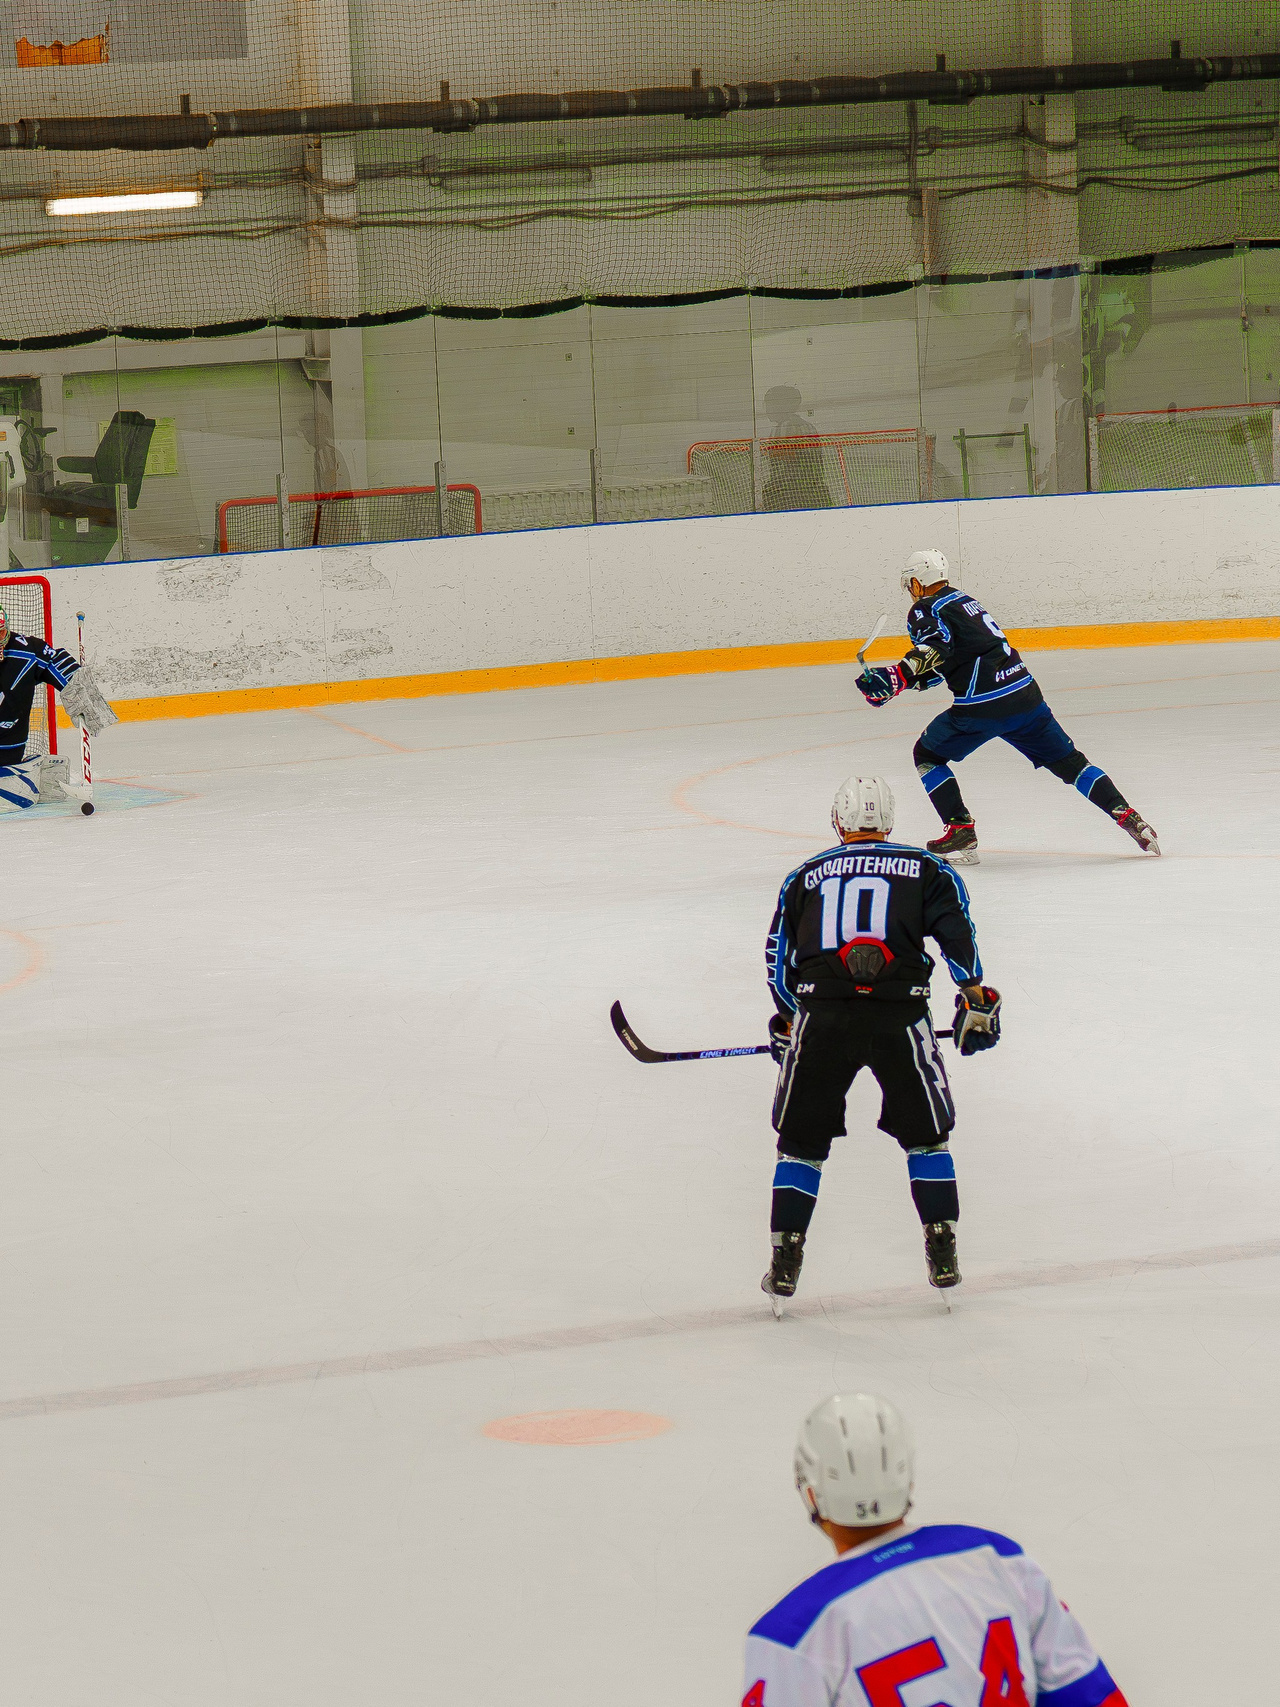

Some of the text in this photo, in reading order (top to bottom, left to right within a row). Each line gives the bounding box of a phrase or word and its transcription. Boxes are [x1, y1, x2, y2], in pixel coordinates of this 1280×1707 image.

[82, 727, 93, 785] CCM
[864, 801, 875, 811] 10
[819, 875, 892, 950] 10
[699, 1046, 757, 1060] ONE TIMER
[855, 1499, 880, 1520] 54
